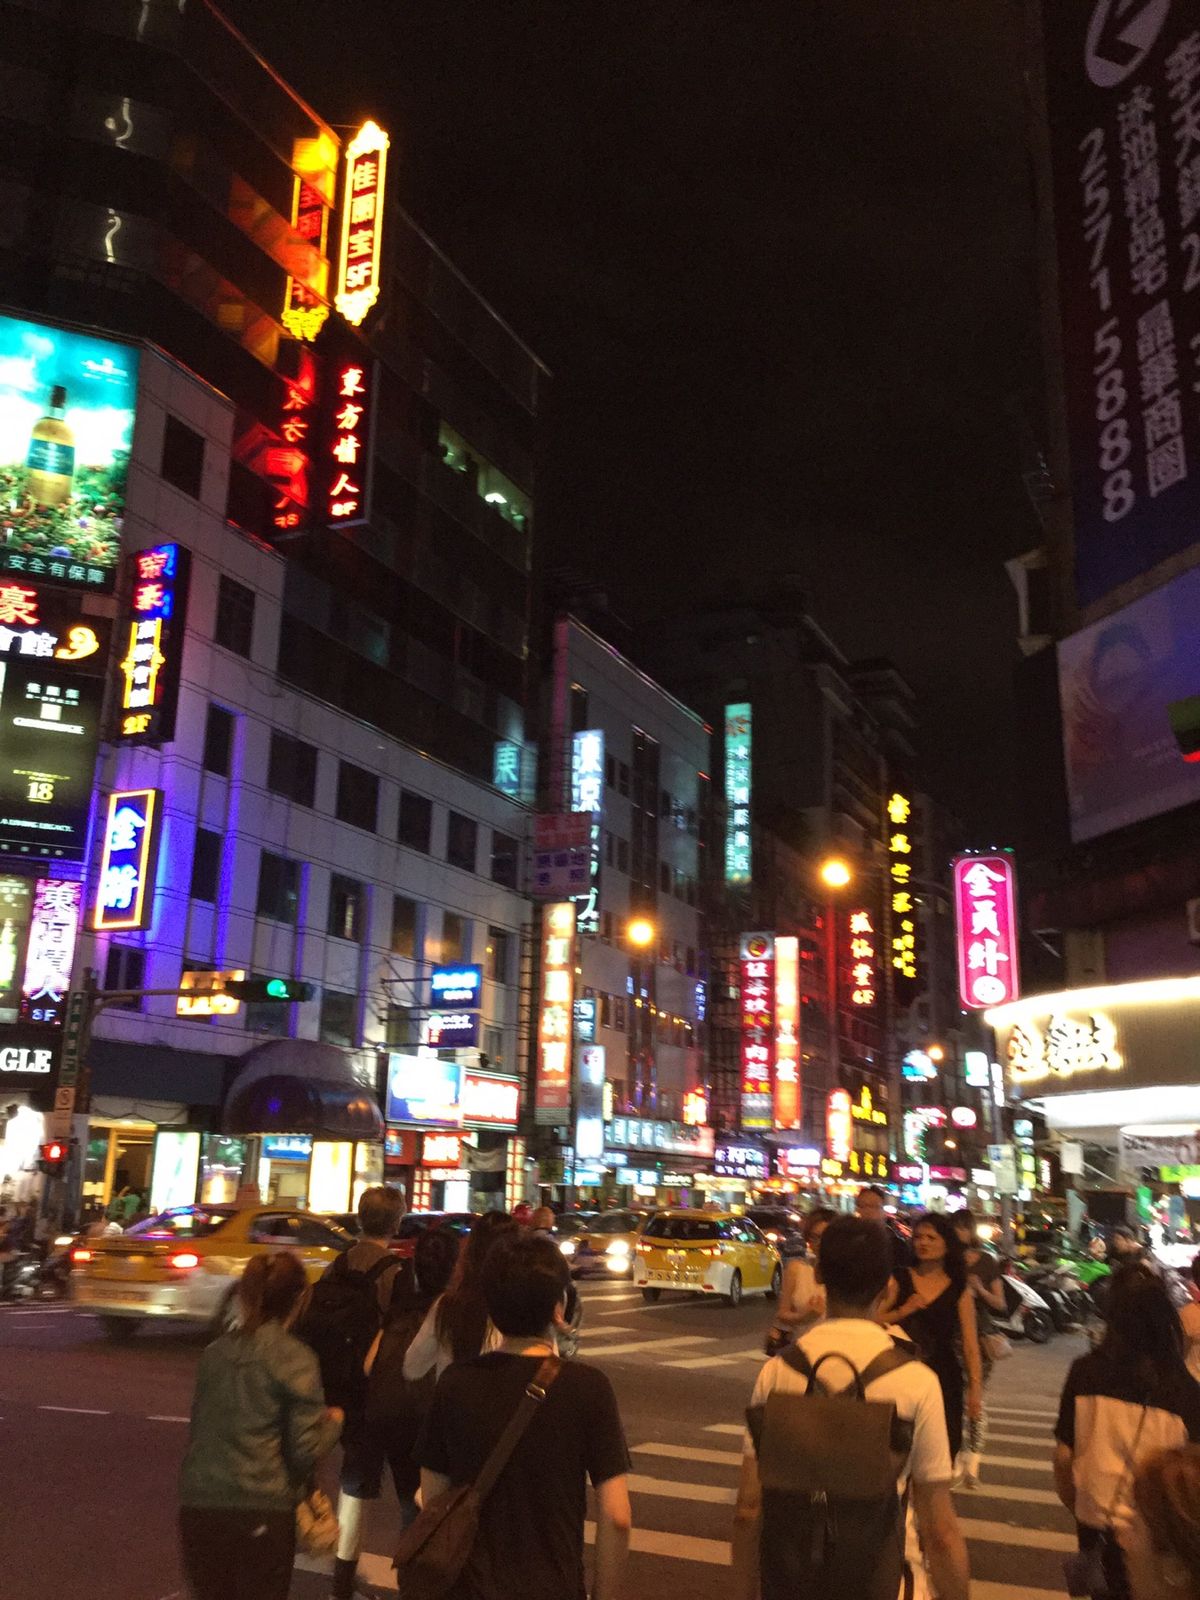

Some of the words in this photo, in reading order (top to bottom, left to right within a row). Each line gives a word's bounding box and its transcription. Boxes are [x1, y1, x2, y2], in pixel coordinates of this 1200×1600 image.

[330, 368, 365, 497] 東方情人
[8, 554, 107, 585] 安全有保障
[27, 782, 55, 802] 18
